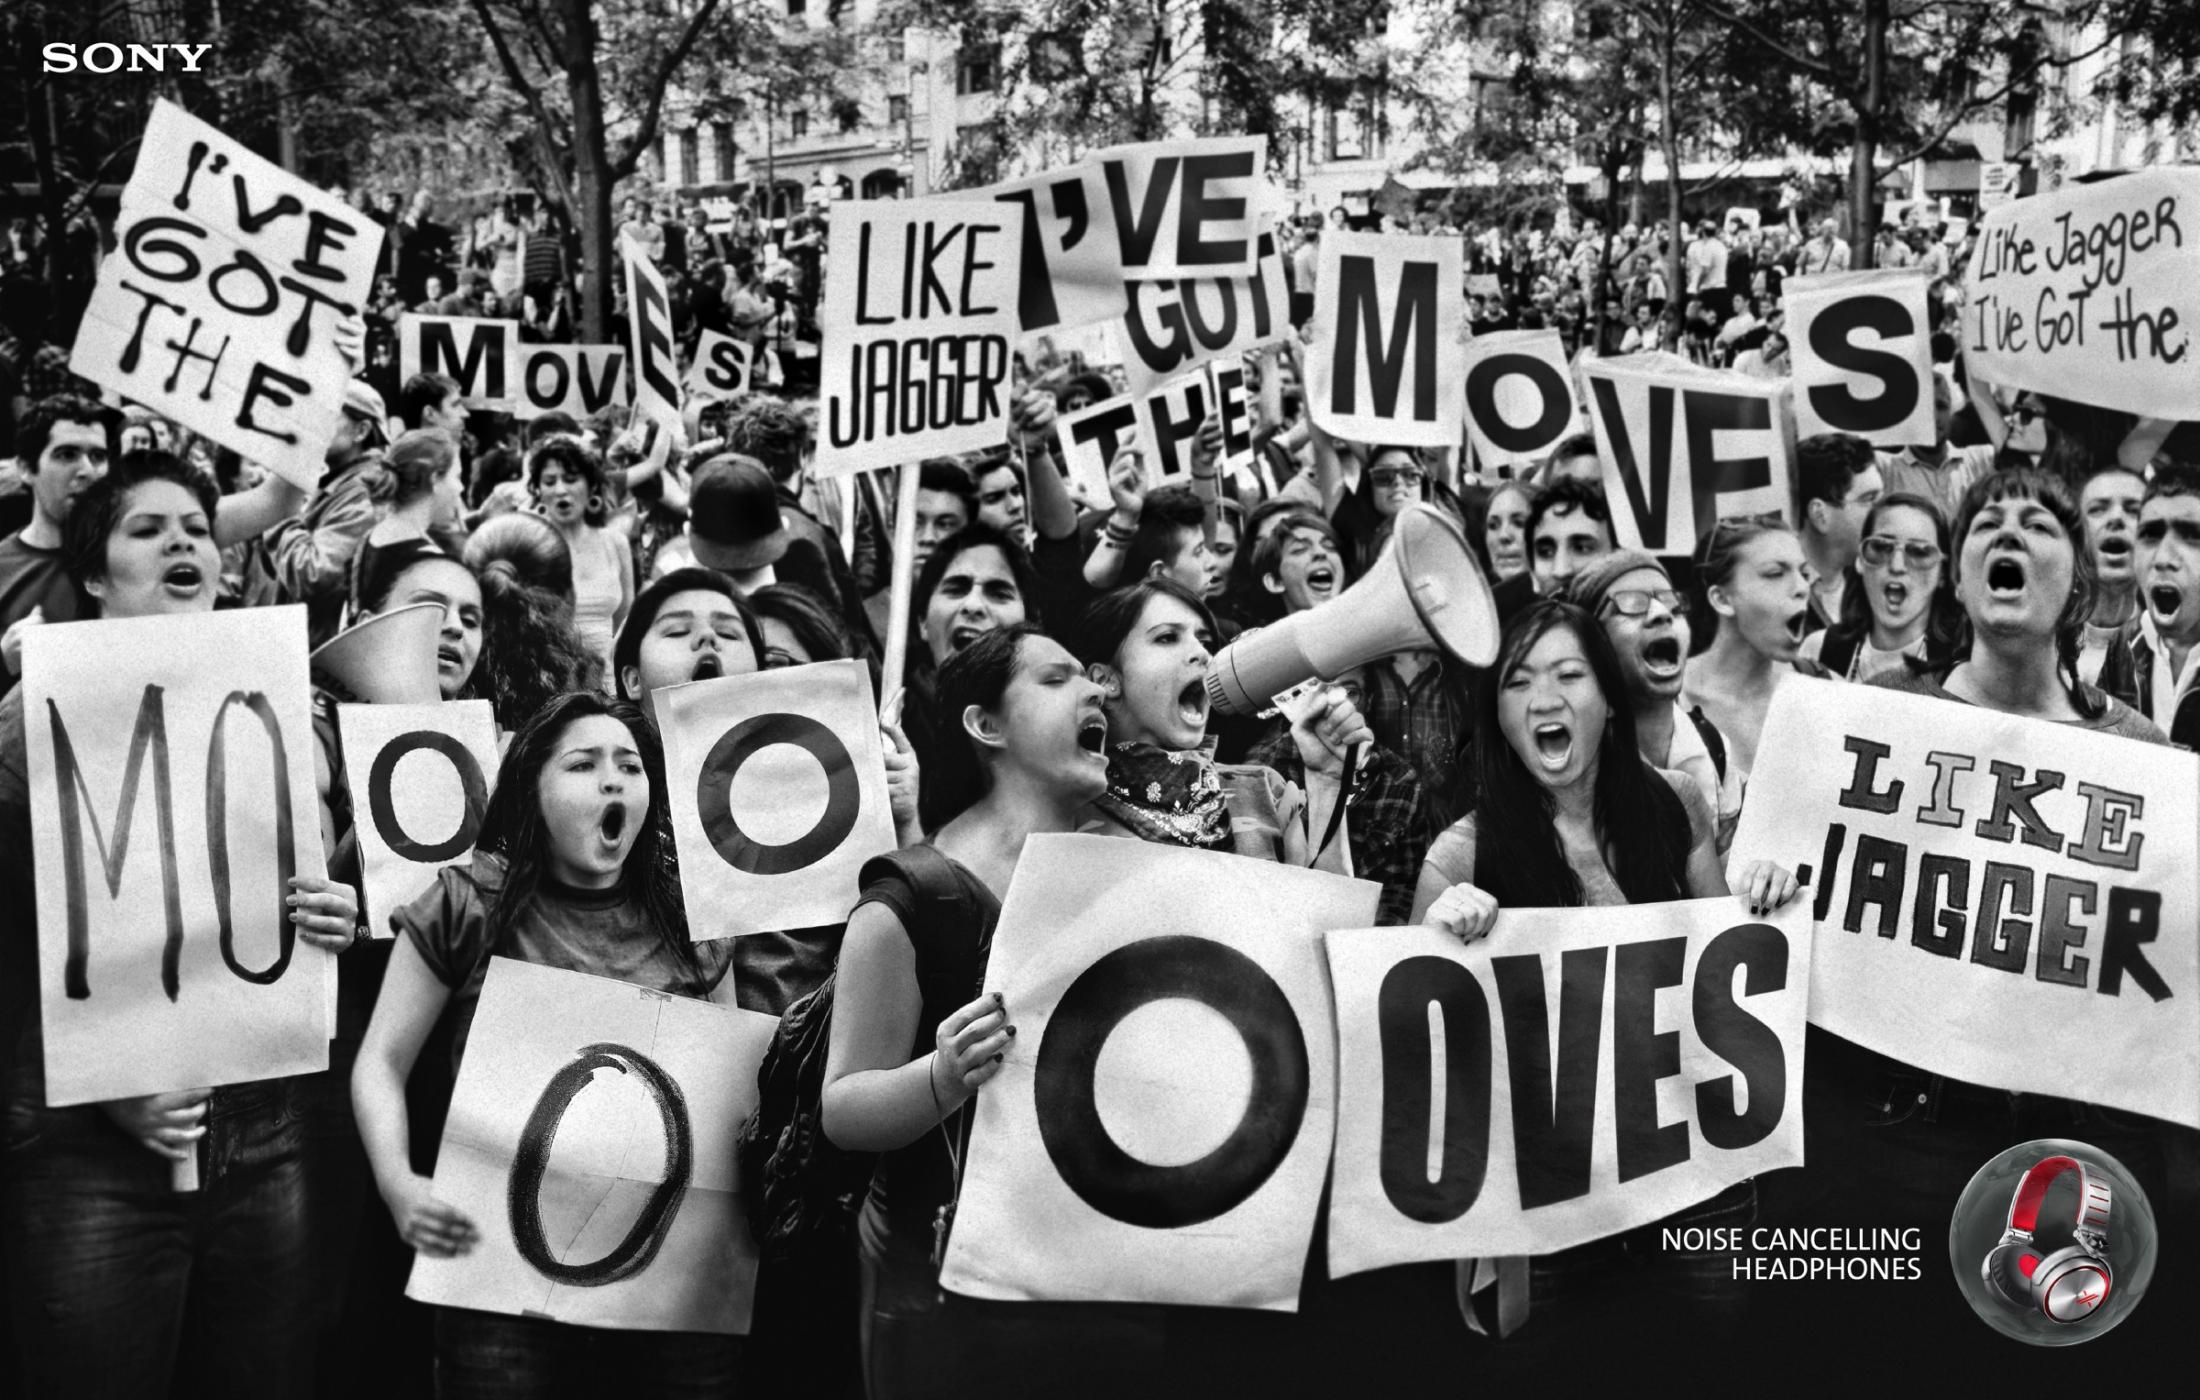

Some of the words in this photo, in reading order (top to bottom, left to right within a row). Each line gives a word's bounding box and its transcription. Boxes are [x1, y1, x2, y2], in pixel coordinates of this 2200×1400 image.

[173, 141, 357, 282] I'VE
[856, 221, 1001, 325] LIKE
[1979, 223, 2037, 282] Like
[124, 217, 356, 357] GOT
[2099, 287, 2186, 364] the
[119, 279, 311, 444] THE
[830, 334, 1007, 448] JAGGER
[46, 683, 296, 1003] MO
[368, 730, 488, 862] O
[697, 713, 860, 875] O
[1839, 734, 2144, 871] LIKE
[1797, 823, 2173, 1003] JAGGER
[1034, 934, 1310, 1229] O
[1379, 922, 1789, 1225] OVES
[508, 1042, 693, 1287] O
